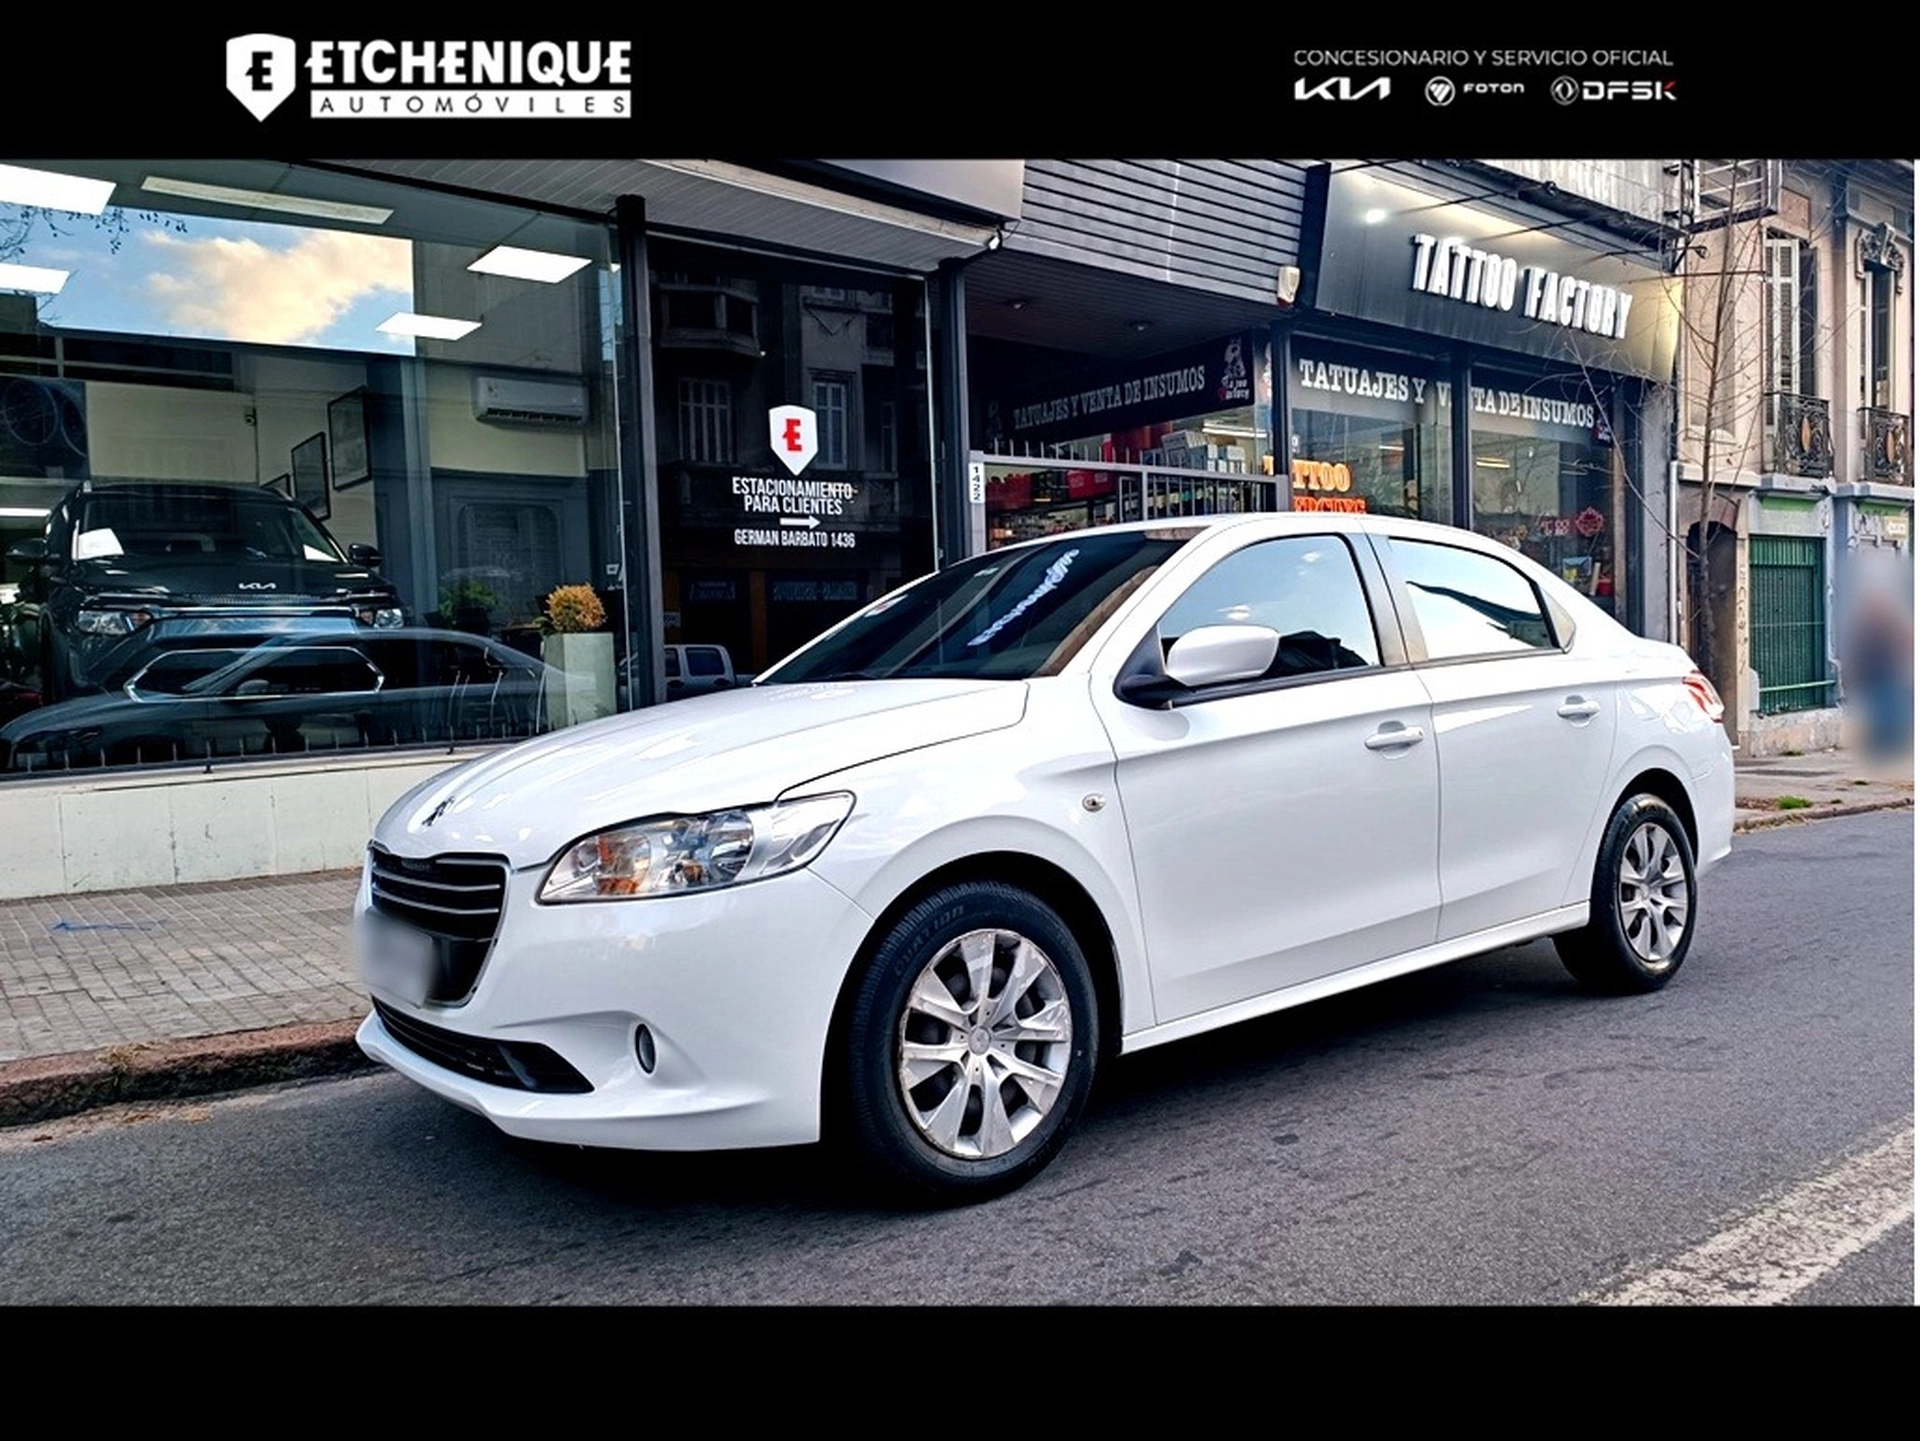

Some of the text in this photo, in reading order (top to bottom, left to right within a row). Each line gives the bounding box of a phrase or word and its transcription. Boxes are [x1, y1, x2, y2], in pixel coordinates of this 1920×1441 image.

[1412, 233, 1633, 339] TATTOO FACTORY
[1013, 401, 1071, 430] TATUAJES
[1069, 396, 1080, 419] Y
[1081, 384, 1122, 414] VENTA
[1124, 380, 1142, 405] DE
[1144, 365, 1206, 401] INSUMOS
[1300, 358, 1409, 401] TATUAJES
[1411, 379, 1426, 404] Y
[1498, 391, 1521, 418] DE
[1521, 396, 1595, 429] INSUMOS
[732, 477, 853, 500] ESTACIONAMIENTO
[744, 495, 843, 515] PARA CLIENTES
[734, 529, 855, 548] GERMAN BARBATO 1436
